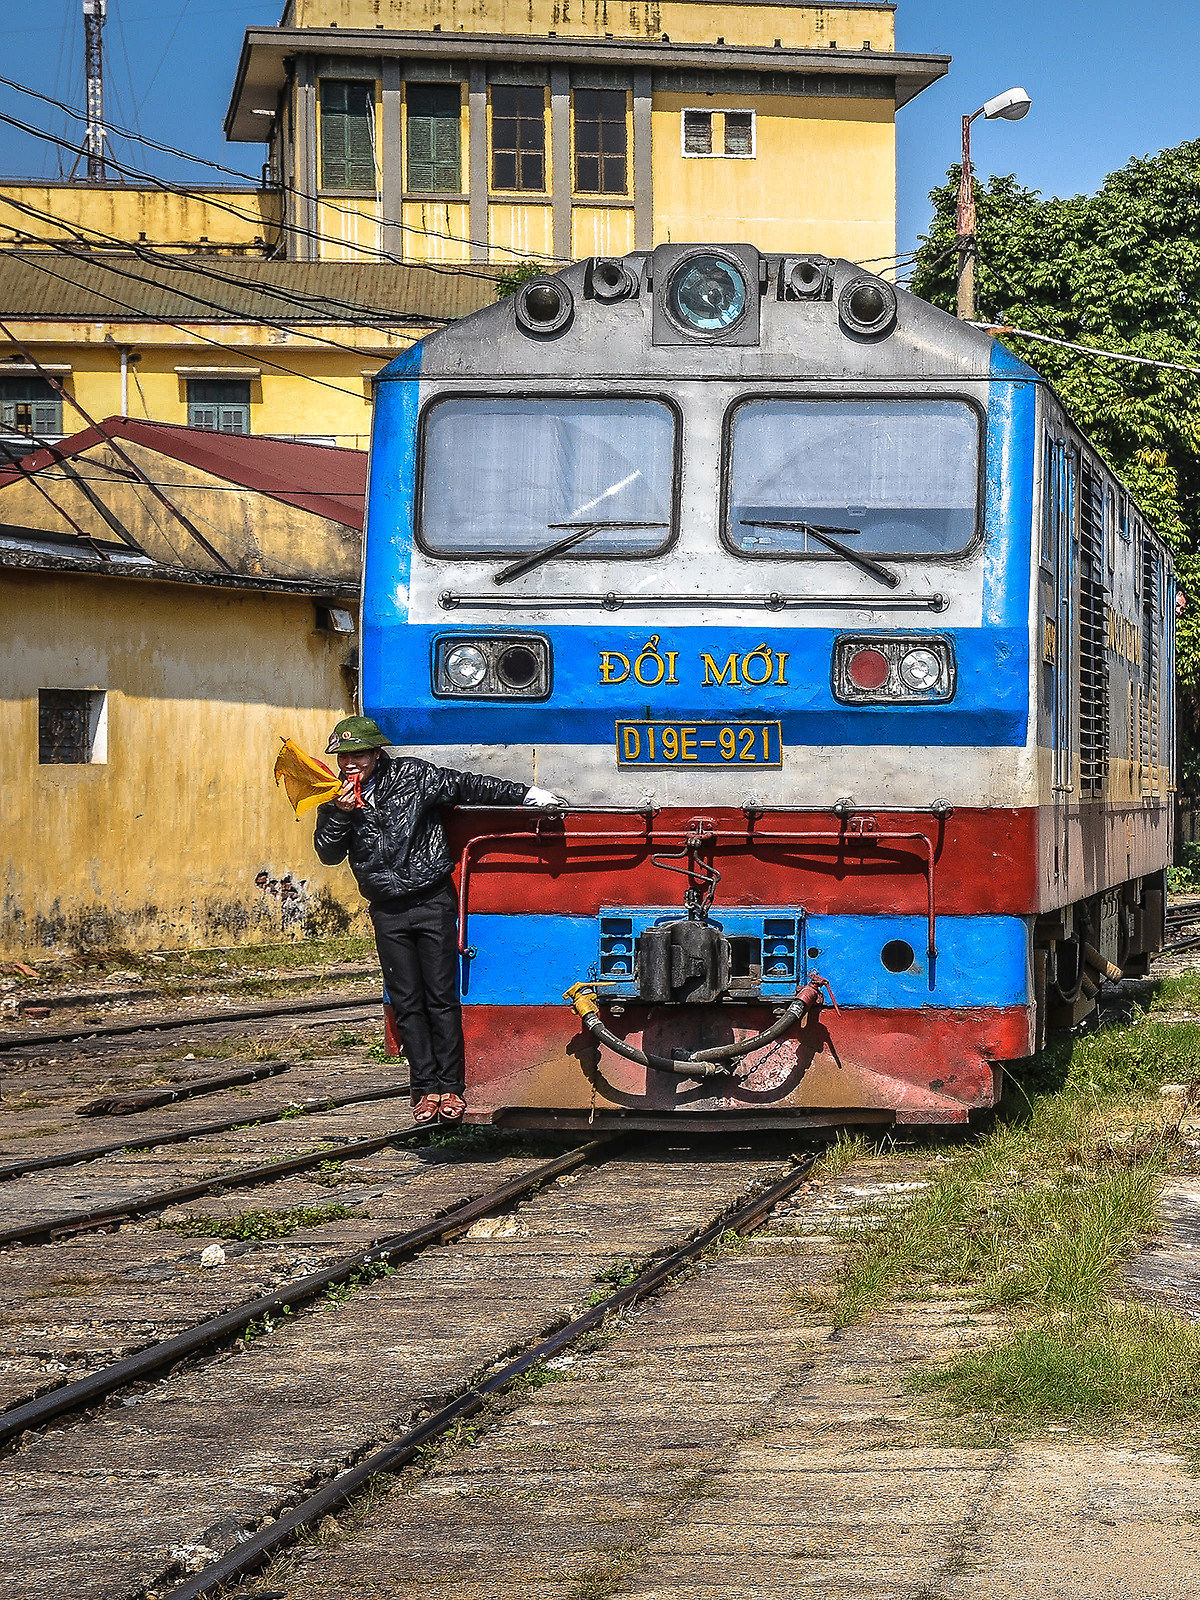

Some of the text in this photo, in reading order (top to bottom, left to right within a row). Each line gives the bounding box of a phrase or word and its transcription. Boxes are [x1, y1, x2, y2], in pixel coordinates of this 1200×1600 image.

[599, 634, 790, 687] ĐỔI MỚI
[622, 726, 771, 762] D19E-921
